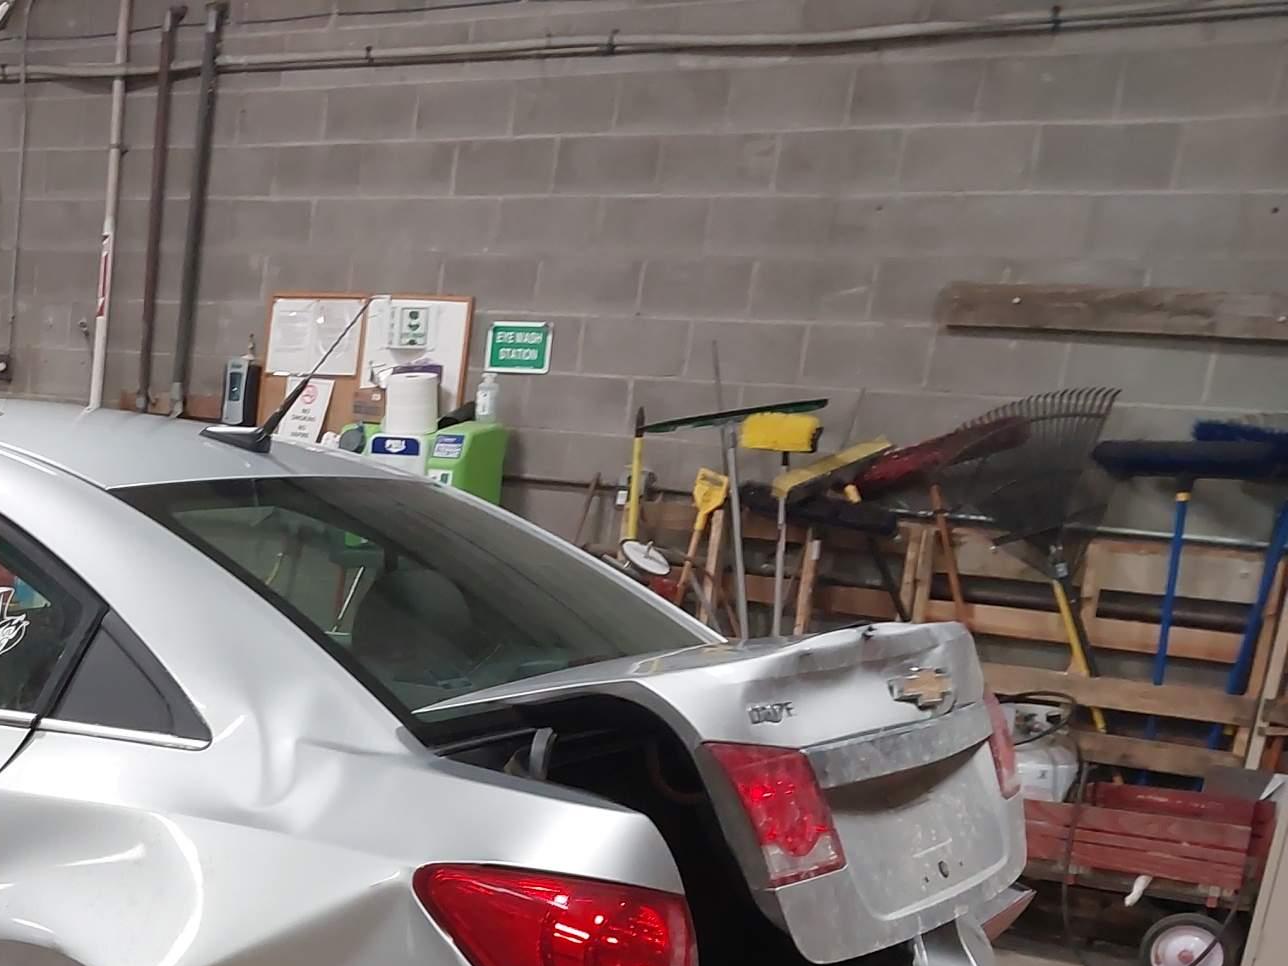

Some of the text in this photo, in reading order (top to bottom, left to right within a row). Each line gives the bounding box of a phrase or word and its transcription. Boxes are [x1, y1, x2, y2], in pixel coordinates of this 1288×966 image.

[495, 331, 543, 345] EYE WASH
[498, 347, 538, 361] STATION
